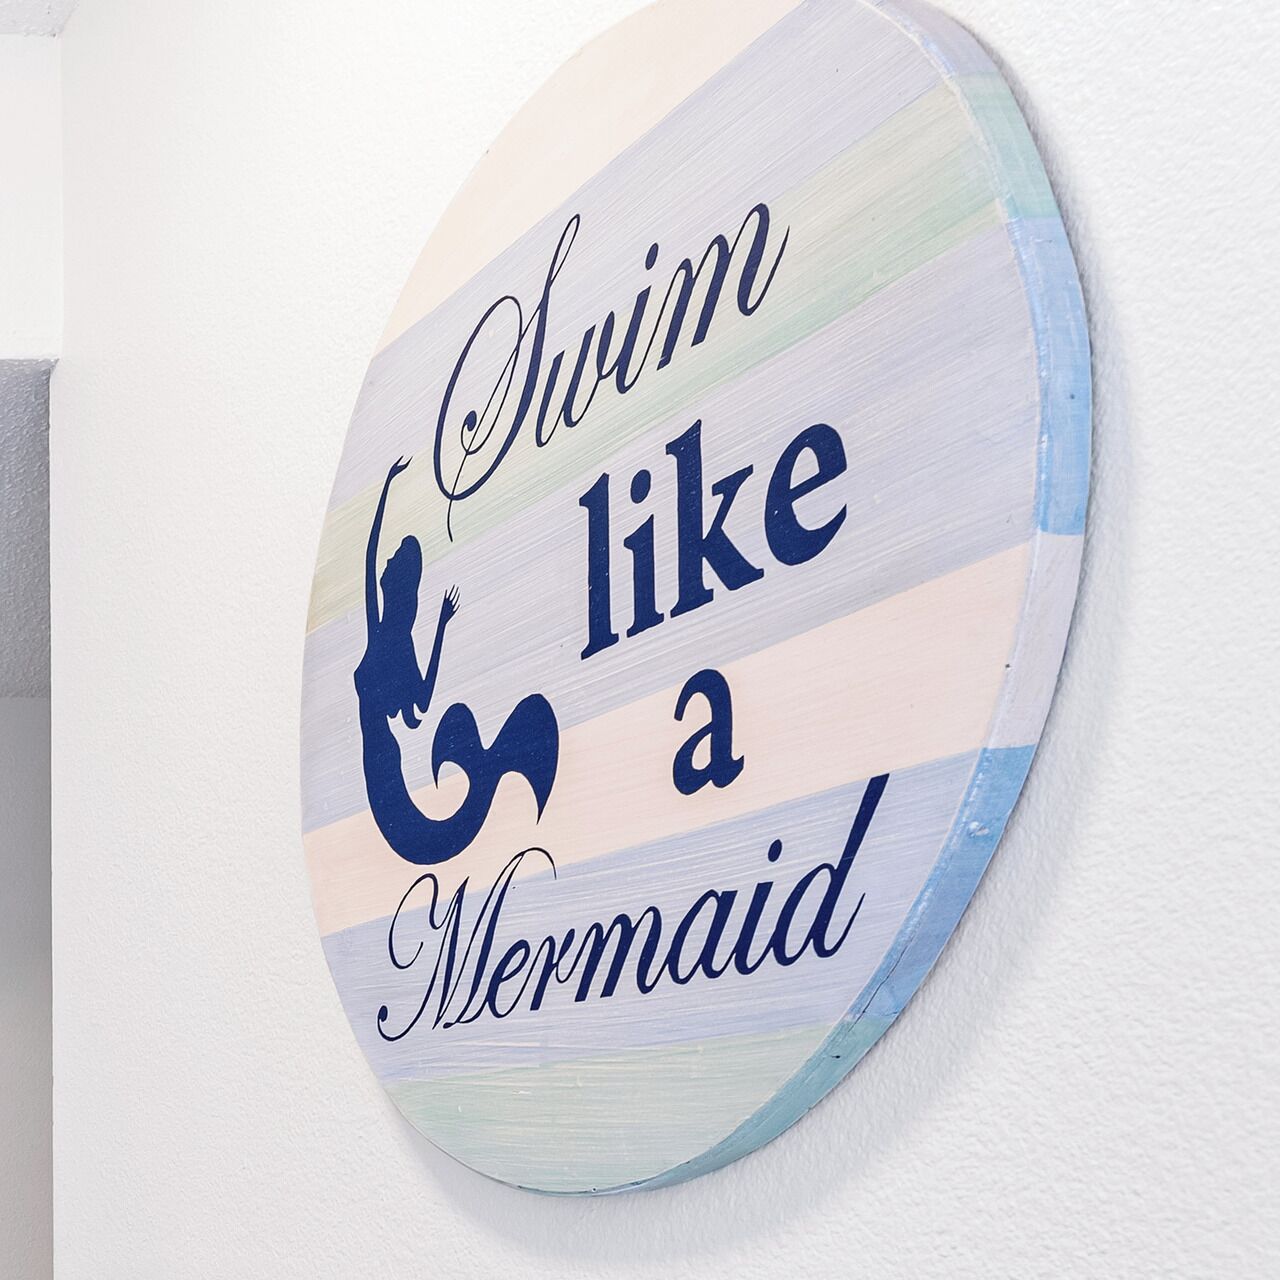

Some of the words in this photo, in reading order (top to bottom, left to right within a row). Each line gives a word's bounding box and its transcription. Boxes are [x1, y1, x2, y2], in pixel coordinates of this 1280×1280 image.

[433, 203, 789, 541] Swim
[580, 419, 848, 660] like
[672, 669, 745, 796] a
[378, 774, 890, 1043] Mermaid
